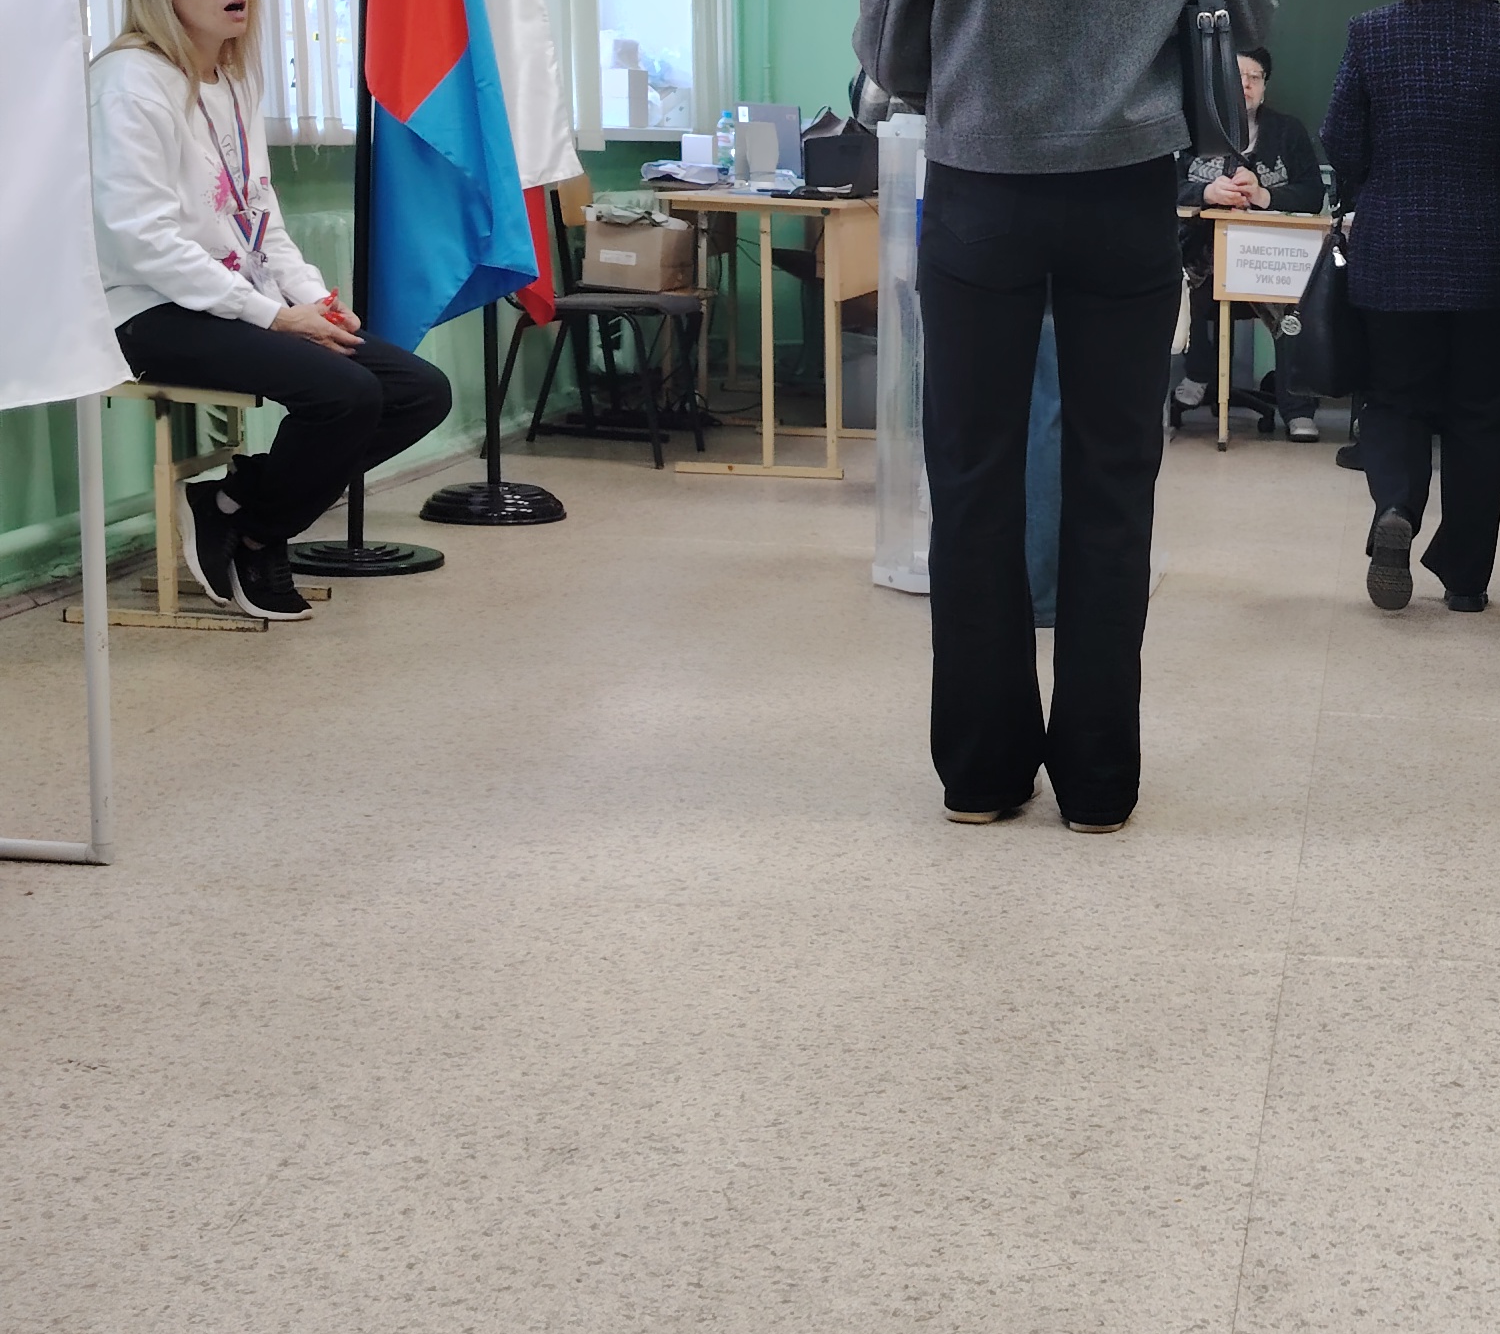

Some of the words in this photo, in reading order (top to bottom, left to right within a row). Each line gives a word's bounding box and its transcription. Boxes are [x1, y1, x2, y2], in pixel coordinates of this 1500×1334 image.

[1239, 244, 1309, 258] ЗАМЕСТИТЕЛЬ
[1235, 258, 1312, 272] ПРЕДСЕДАТЕЛЯ
[1255, 273, 1274, 285] УИК
[1275, 275, 1292, 285] 960
